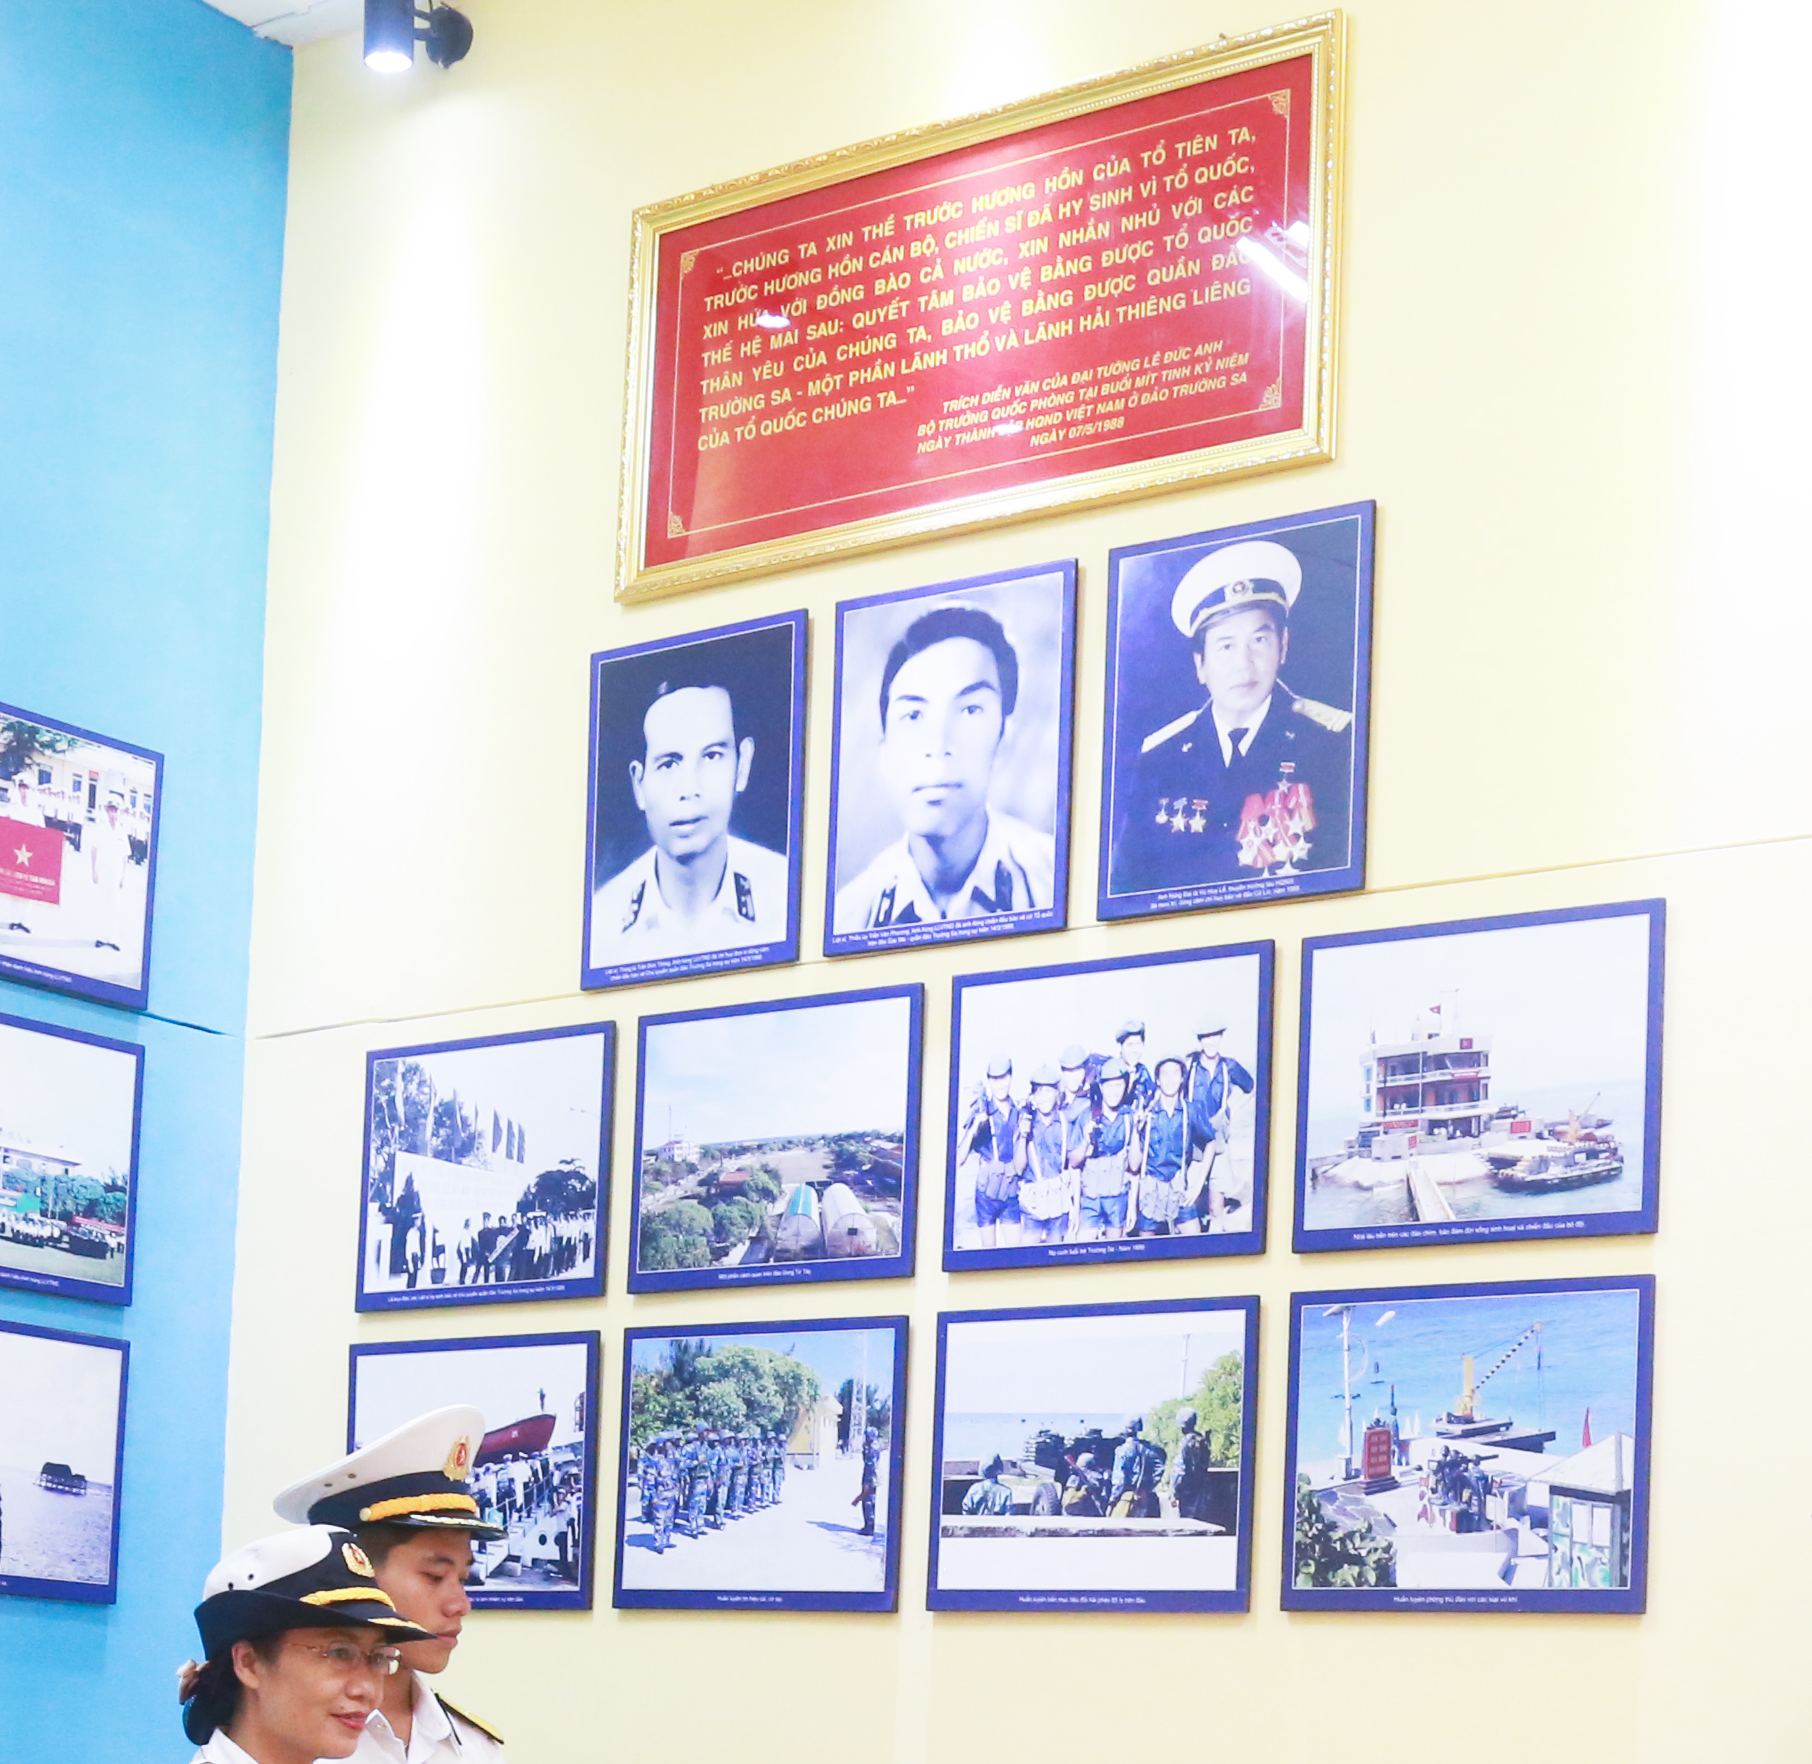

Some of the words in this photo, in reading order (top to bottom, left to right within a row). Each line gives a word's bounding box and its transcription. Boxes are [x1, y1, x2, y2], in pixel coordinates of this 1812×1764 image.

[703, 321, 729, 339] XIN
[780, 297, 808, 322] VỚI
[816, 284, 865, 310] ĐỒNG
[874, 272, 912, 295] BÀO
[919, 258, 945, 283] CẢ
[953, 248, 1008, 275] NƯỚC,
[1018, 237, 1050, 258] XIN
[1058, 220, 1111, 248] NHẮN
[1120, 204, 1161, 232] NHỦ
[1171, 197, 1203, 219] VỚI
[1213, 185, 1255, 209] CÁC
[704, 284, 758, 311] TRƯỚC
[763, 268, 823, 295] HƯƠNG
[828, 256, 864, 278] HỒN
[868, 245, 905, 268] CÁN
[909, 235, 939, 258] BỘ,
[944, 221, 999, 248] CHIẾN
[1005, 209, 1023, 233] SĨ
[1027, 204, 1054, 227] ĐÃ
[1058, 198, 1083, 219] HY
[1089, 186, 1134, 211] SINH
[1139, 176, 1158, 198] VÌ
[1163, 164, 1189, 191] TỔ
[1194, 156, 1254, 184] QUỐC,
[798, 241, 818, 258] TA
[826, 231, 855, 251] XIN
[861, 214, 895, 241] THỀ
[903, 201, 963, 230] TRƯỚC
[972, 182, 1036, 212] HƯƠNG
[1044, 167, 1085, 193] HỒN
[1092, 155, 1132, 181] CỦA
[1140, 140, 1167, 167] TỔ
[1175, 134, 1219, 158] TIÊN
[1228, 126, 1257, 145] TA,
[700, 372, 744, 395] THÂN
[752, 361, 785, 381] YÊU
[793, 348, 828, 372] CỦA
[836, 333, 898, 361] CHÚNG
[906, 325, 932, 343] TA,
[941, 311, 980, 336] BẢO
[988, 301, 1012, 324] VỆ
[1021, 289, 1074, 316] BẰNG
[1083, 275, 1136, 301] ĐƯỢC
[1147, 258, 1201, 286] QUẦN
[700, 394, 766, 422] TRƯỜNG
[770, 387, 793, 405] SA
[807, 374, 844, 396] MỘT
[848, 360, 896, 386] PHẦN
[900, 349, 948, 374] LÃNH
[953, 331, 991, 361] THỔ
[995, 329, 1020, 352] VÀ
[1024, 319, 1074, 345] LÃNH
[1079, 306, 1112, 332] HẢI
[1116, 293, 1187, 322] THIÊNG
[1192, 278, 1251, 305] LIÊNG
[701, 344, 732, 367] THẾ
[740, 337, 762, 357] HỆ
[770, 324, 799, 349] MAI
[806, 319, 843, 341] SAU:
[852, 298, 910, 329] QUYẾT
[918, 289, 955, 312] TÂM
[962, 277, 1001, 301] BẢO
[1008, 267, 1032, 290] VỆ
[1040, 255, 1093, 282] BẰNG
[1101, 240, 1154, 267] ĐƯỢC
[1163, 224, 1190, 251] TỔ
[1197, 216, 1253, 243] QUỐC
[697, 431, 731, 451] CỦA
[735, 421, 757, 441] TỔ
[760, 411, 807, 436] QUỐC
[811, 396, 873, 424] CHÚNG
